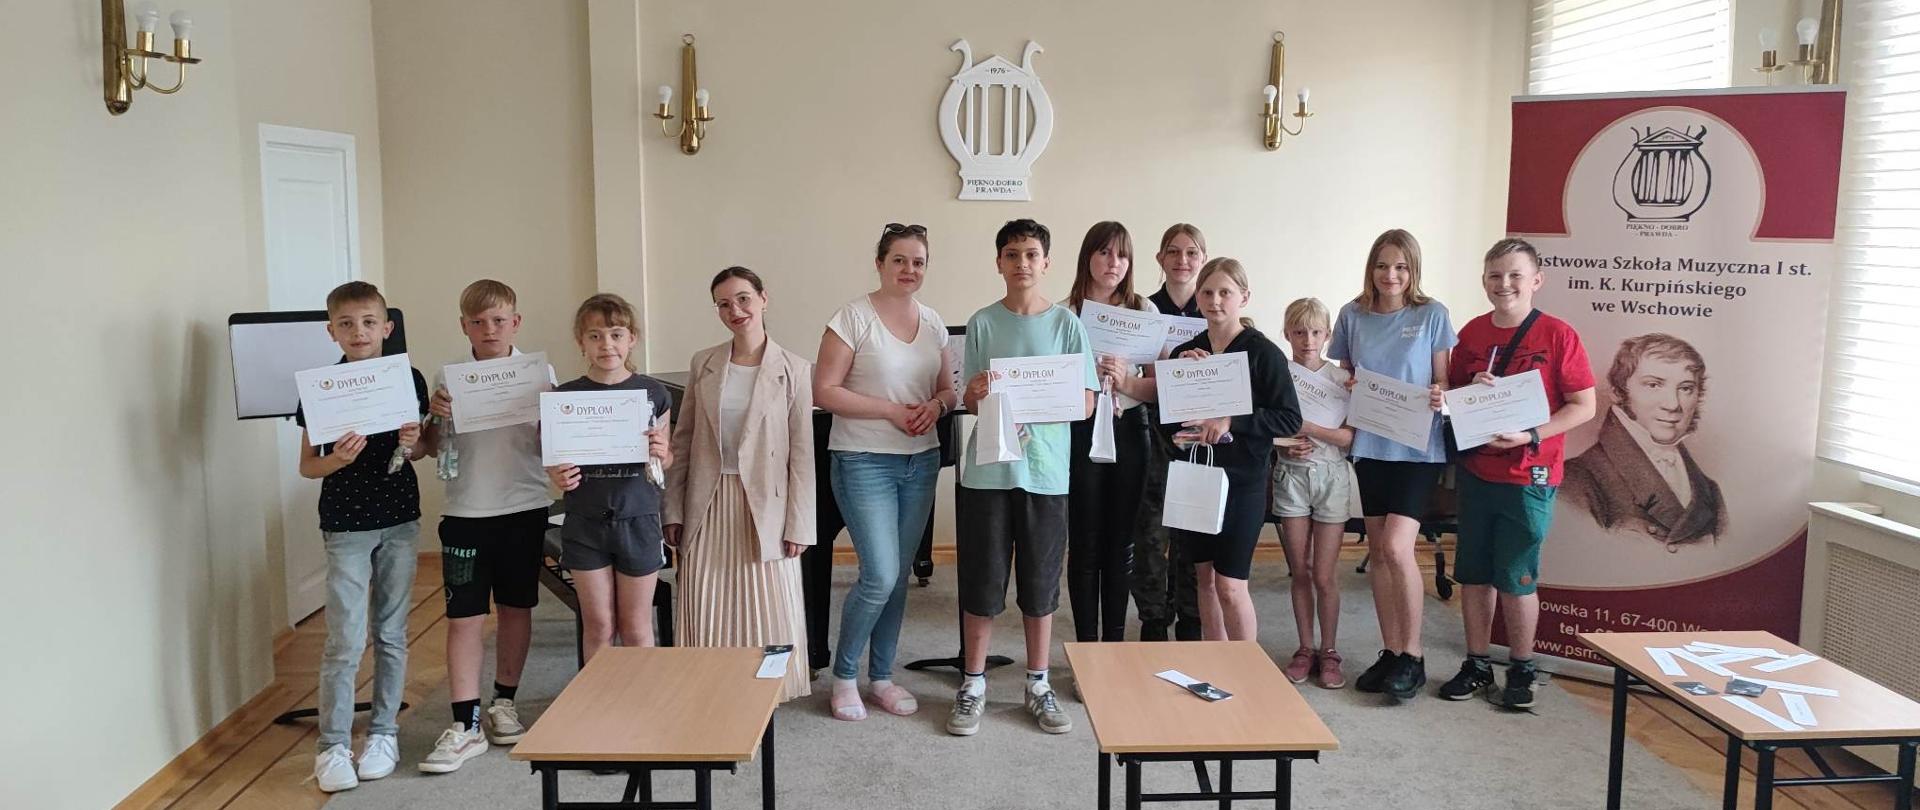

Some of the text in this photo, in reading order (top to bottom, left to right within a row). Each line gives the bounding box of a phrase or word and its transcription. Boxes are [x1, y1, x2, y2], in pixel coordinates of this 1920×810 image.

[1612, 256, 1672, 271] Szkoła
[1677, 258, 1771, 277] Muzyczna
[1776, 261, 1783, 275] I
[1788, 264, 1812, 276] st.
[1568, 276, 1747, 300] im. K. Kurpińskiego
[1591, 300, 1713, 318] we Wschowie
[1109, 318, 1141, 331] DYPLOM
[480, 370, 516, 384] DYPLOM
[1022, 369, 1054, 379] DYPLOM
[1186, 368, 1219, 379] DYPLOM
[336, 374, 376, 390] DYPLOM
[1299, 378, 1328, 399] DYPLOM
[1378, 387, 1408, 402] DYPLOM
[1478, 389, 1512, 403] DYPLOM
[576, 405, 613, 416] DYPLOM
[1620, 612, 1678, 632] 67-400
